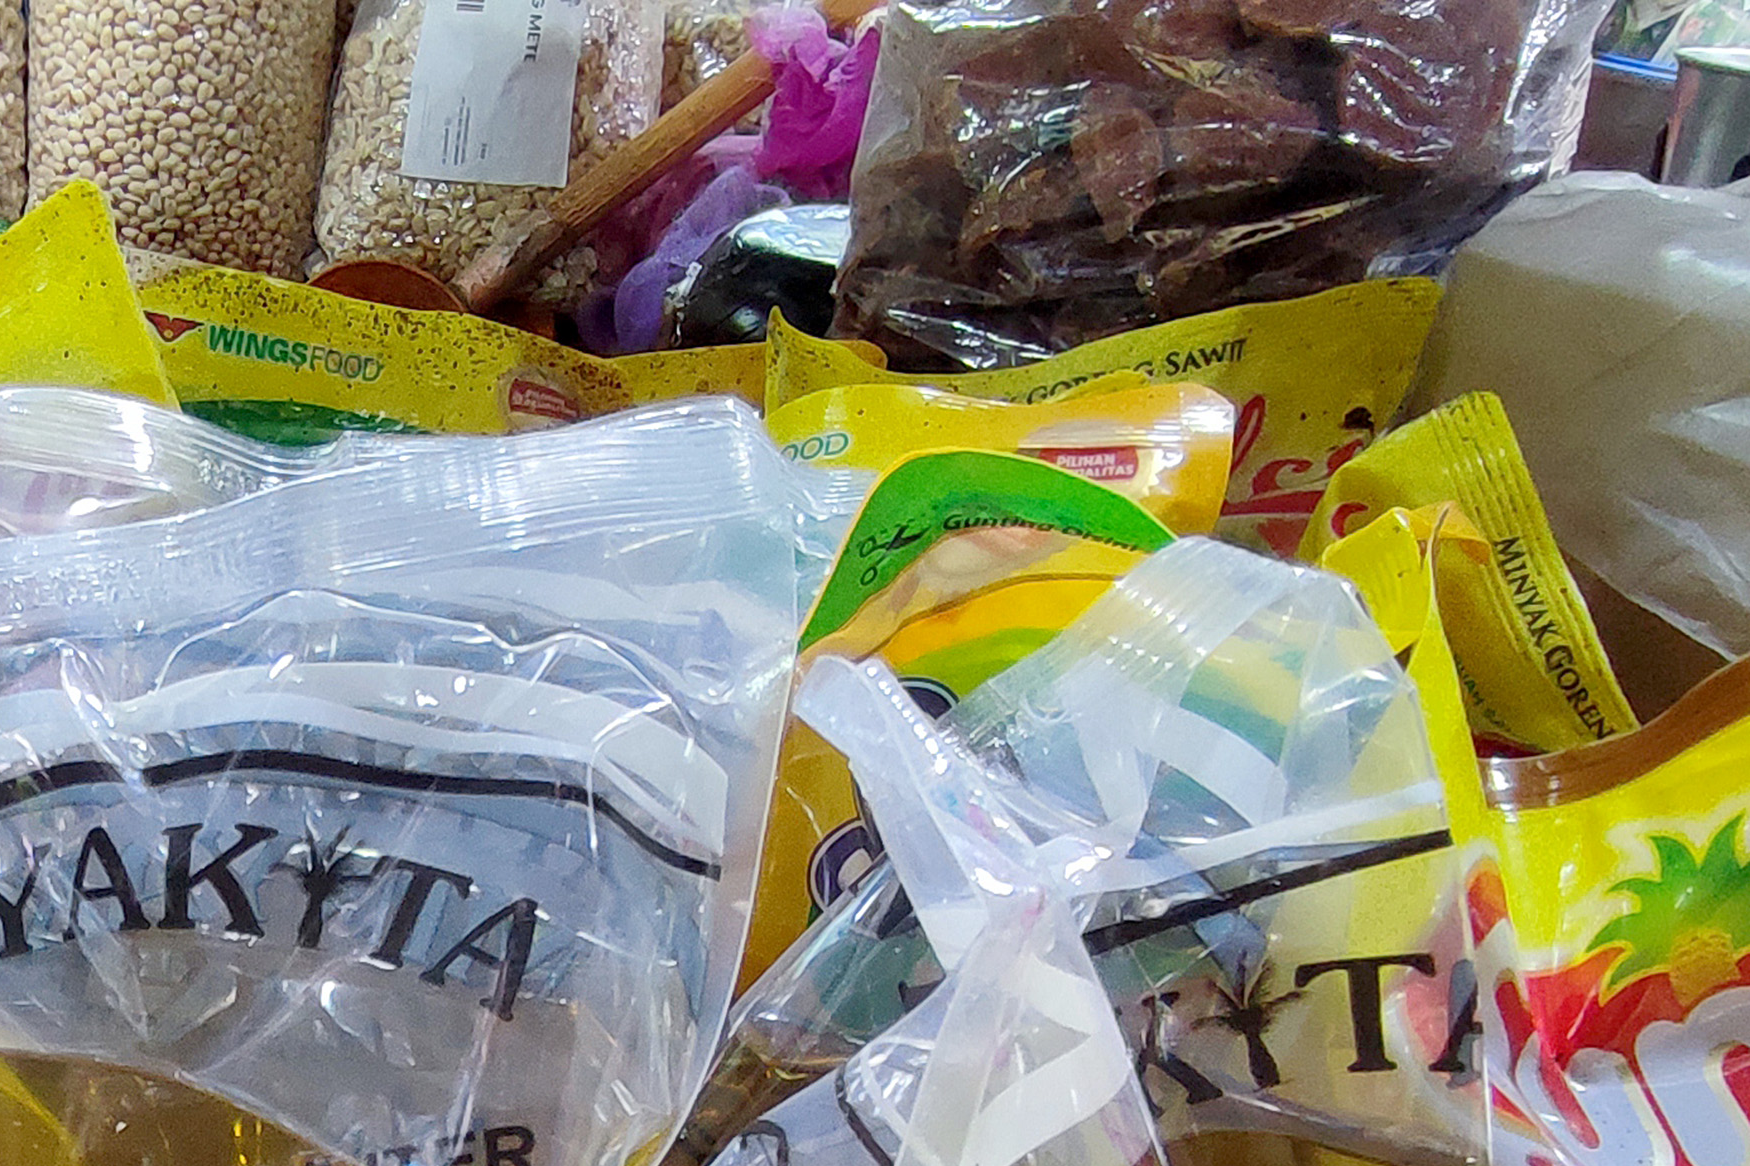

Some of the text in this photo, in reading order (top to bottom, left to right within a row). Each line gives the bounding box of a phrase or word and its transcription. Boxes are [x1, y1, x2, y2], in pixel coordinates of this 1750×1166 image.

[523, 14, 543, 62] METE
[207, 324, 385, 383] WINGSFOOD
[1026, 338, 1247, 404] GORG SAWIT
[1055, 454, 1117, 470] PILIHAN
[1494, 536, 1617, 740] MINYAK GOREN
